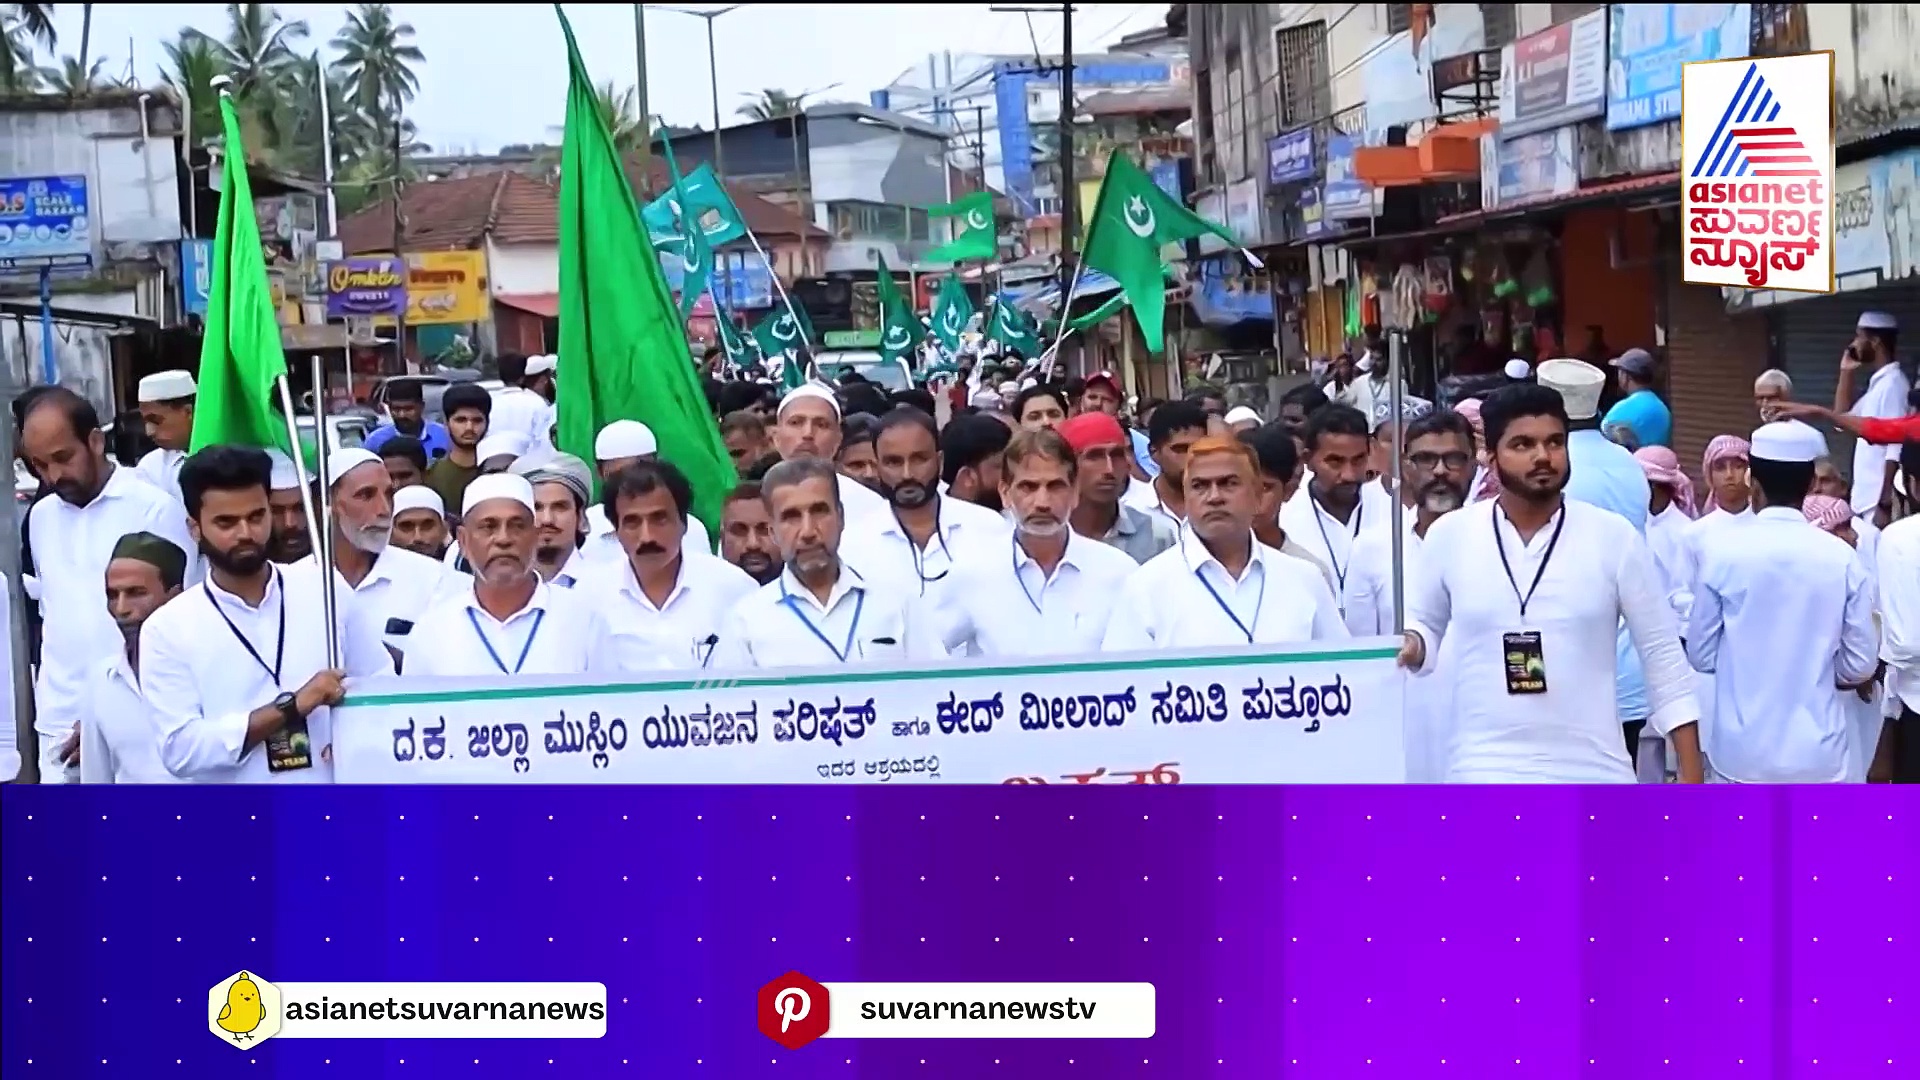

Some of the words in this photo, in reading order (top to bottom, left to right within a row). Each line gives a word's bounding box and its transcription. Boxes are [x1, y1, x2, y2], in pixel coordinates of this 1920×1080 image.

[468, 723, 530, 773] ಜಿಲ್ಲಾ
[543, 709, 628, 768] ಮುಸ್ಲಿಂ
[642, 699, 759, 749] ಯುವಜನ
[772, 695, 877, 747] ಪರಿಷತ್
[892, 715, 931, 737] ಹಾಗೂ
[936, 690, 1004, 735] ಈದ್
[1019, 685, 1137, 731] ಮೀಲಾದ್
[1150, 680, 1228, 725] ಸಮಿತಿ
[1242, 673, 1352, 733] ಪುತ್ತೂರು
[816, 761, 855, 779] ಇದರ
[864, 755, 941, 782] ಆಶ್ರಯದಲ್ಲಿ
